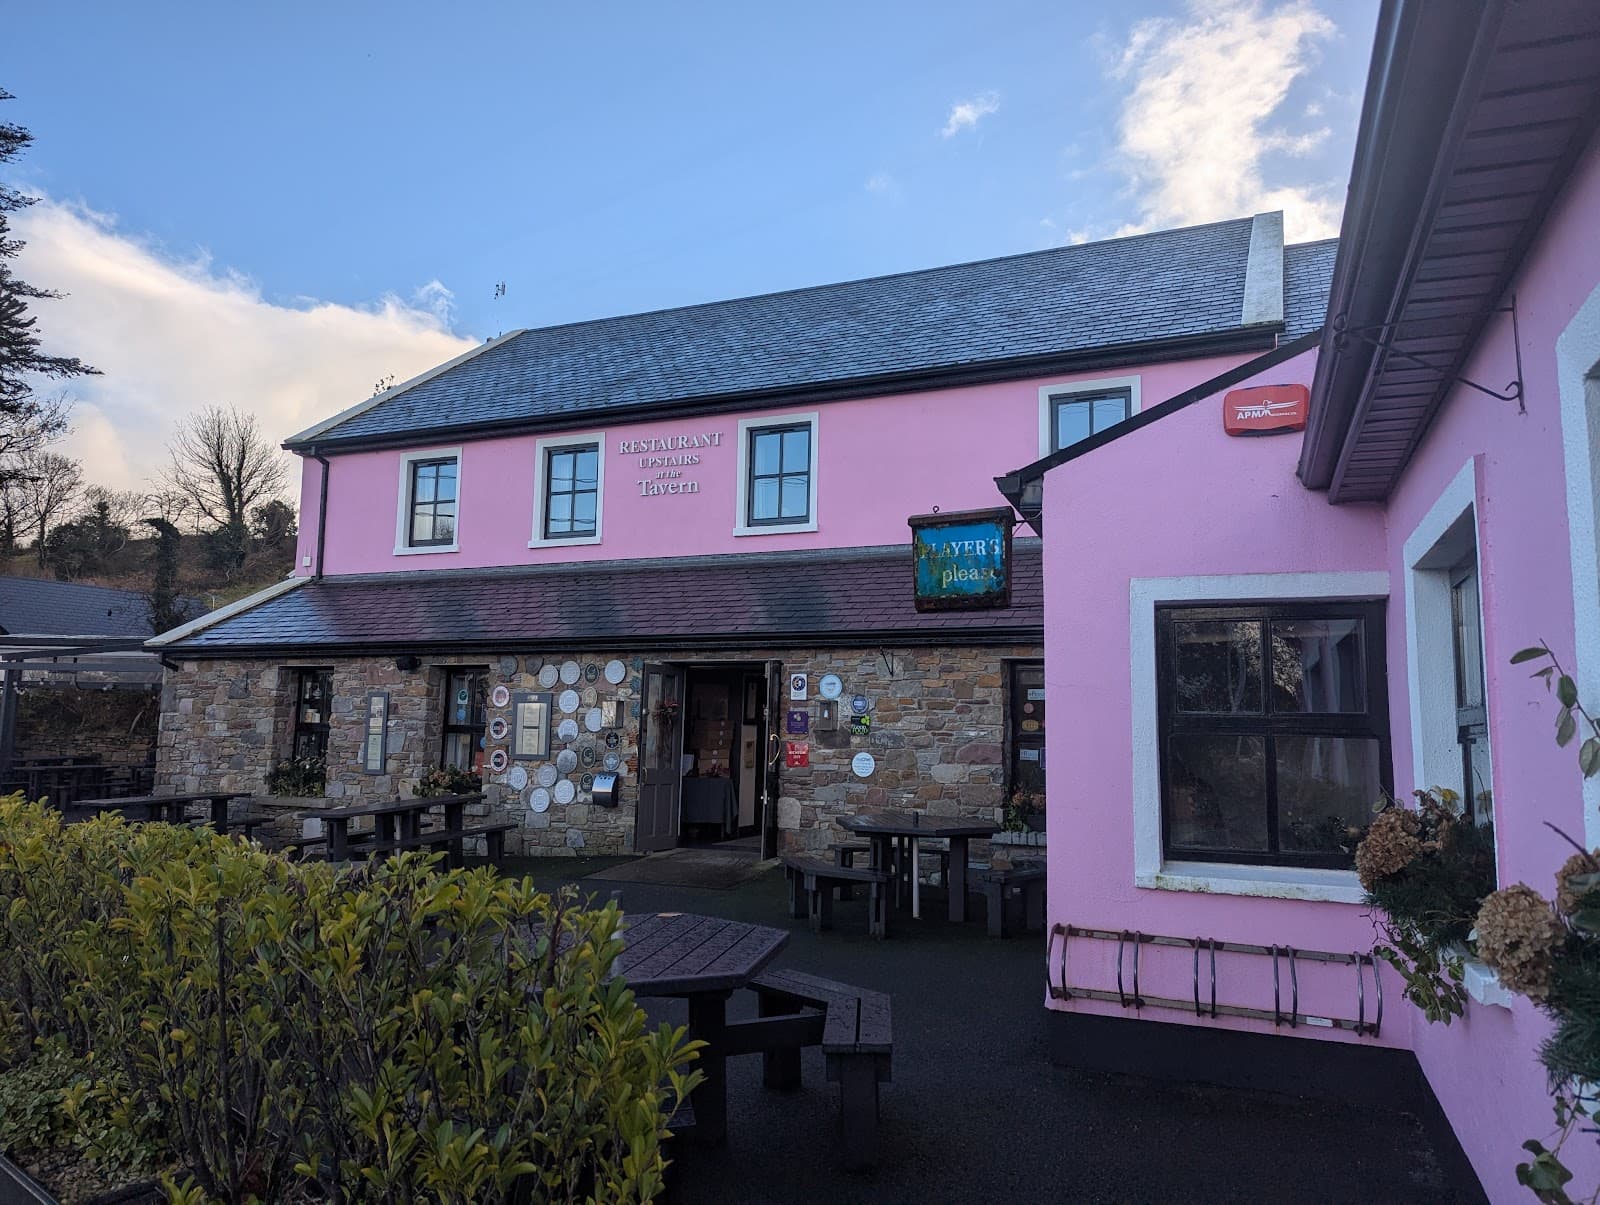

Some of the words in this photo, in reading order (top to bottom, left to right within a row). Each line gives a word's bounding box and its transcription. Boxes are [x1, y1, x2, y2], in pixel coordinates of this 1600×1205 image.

[619, 432, 723, 454] RESTAURANT
[639, 454, 700, 468] UPSTAIRS
[666, 469, 681, 478] the
[637, 480, 699, 496] Tavern
